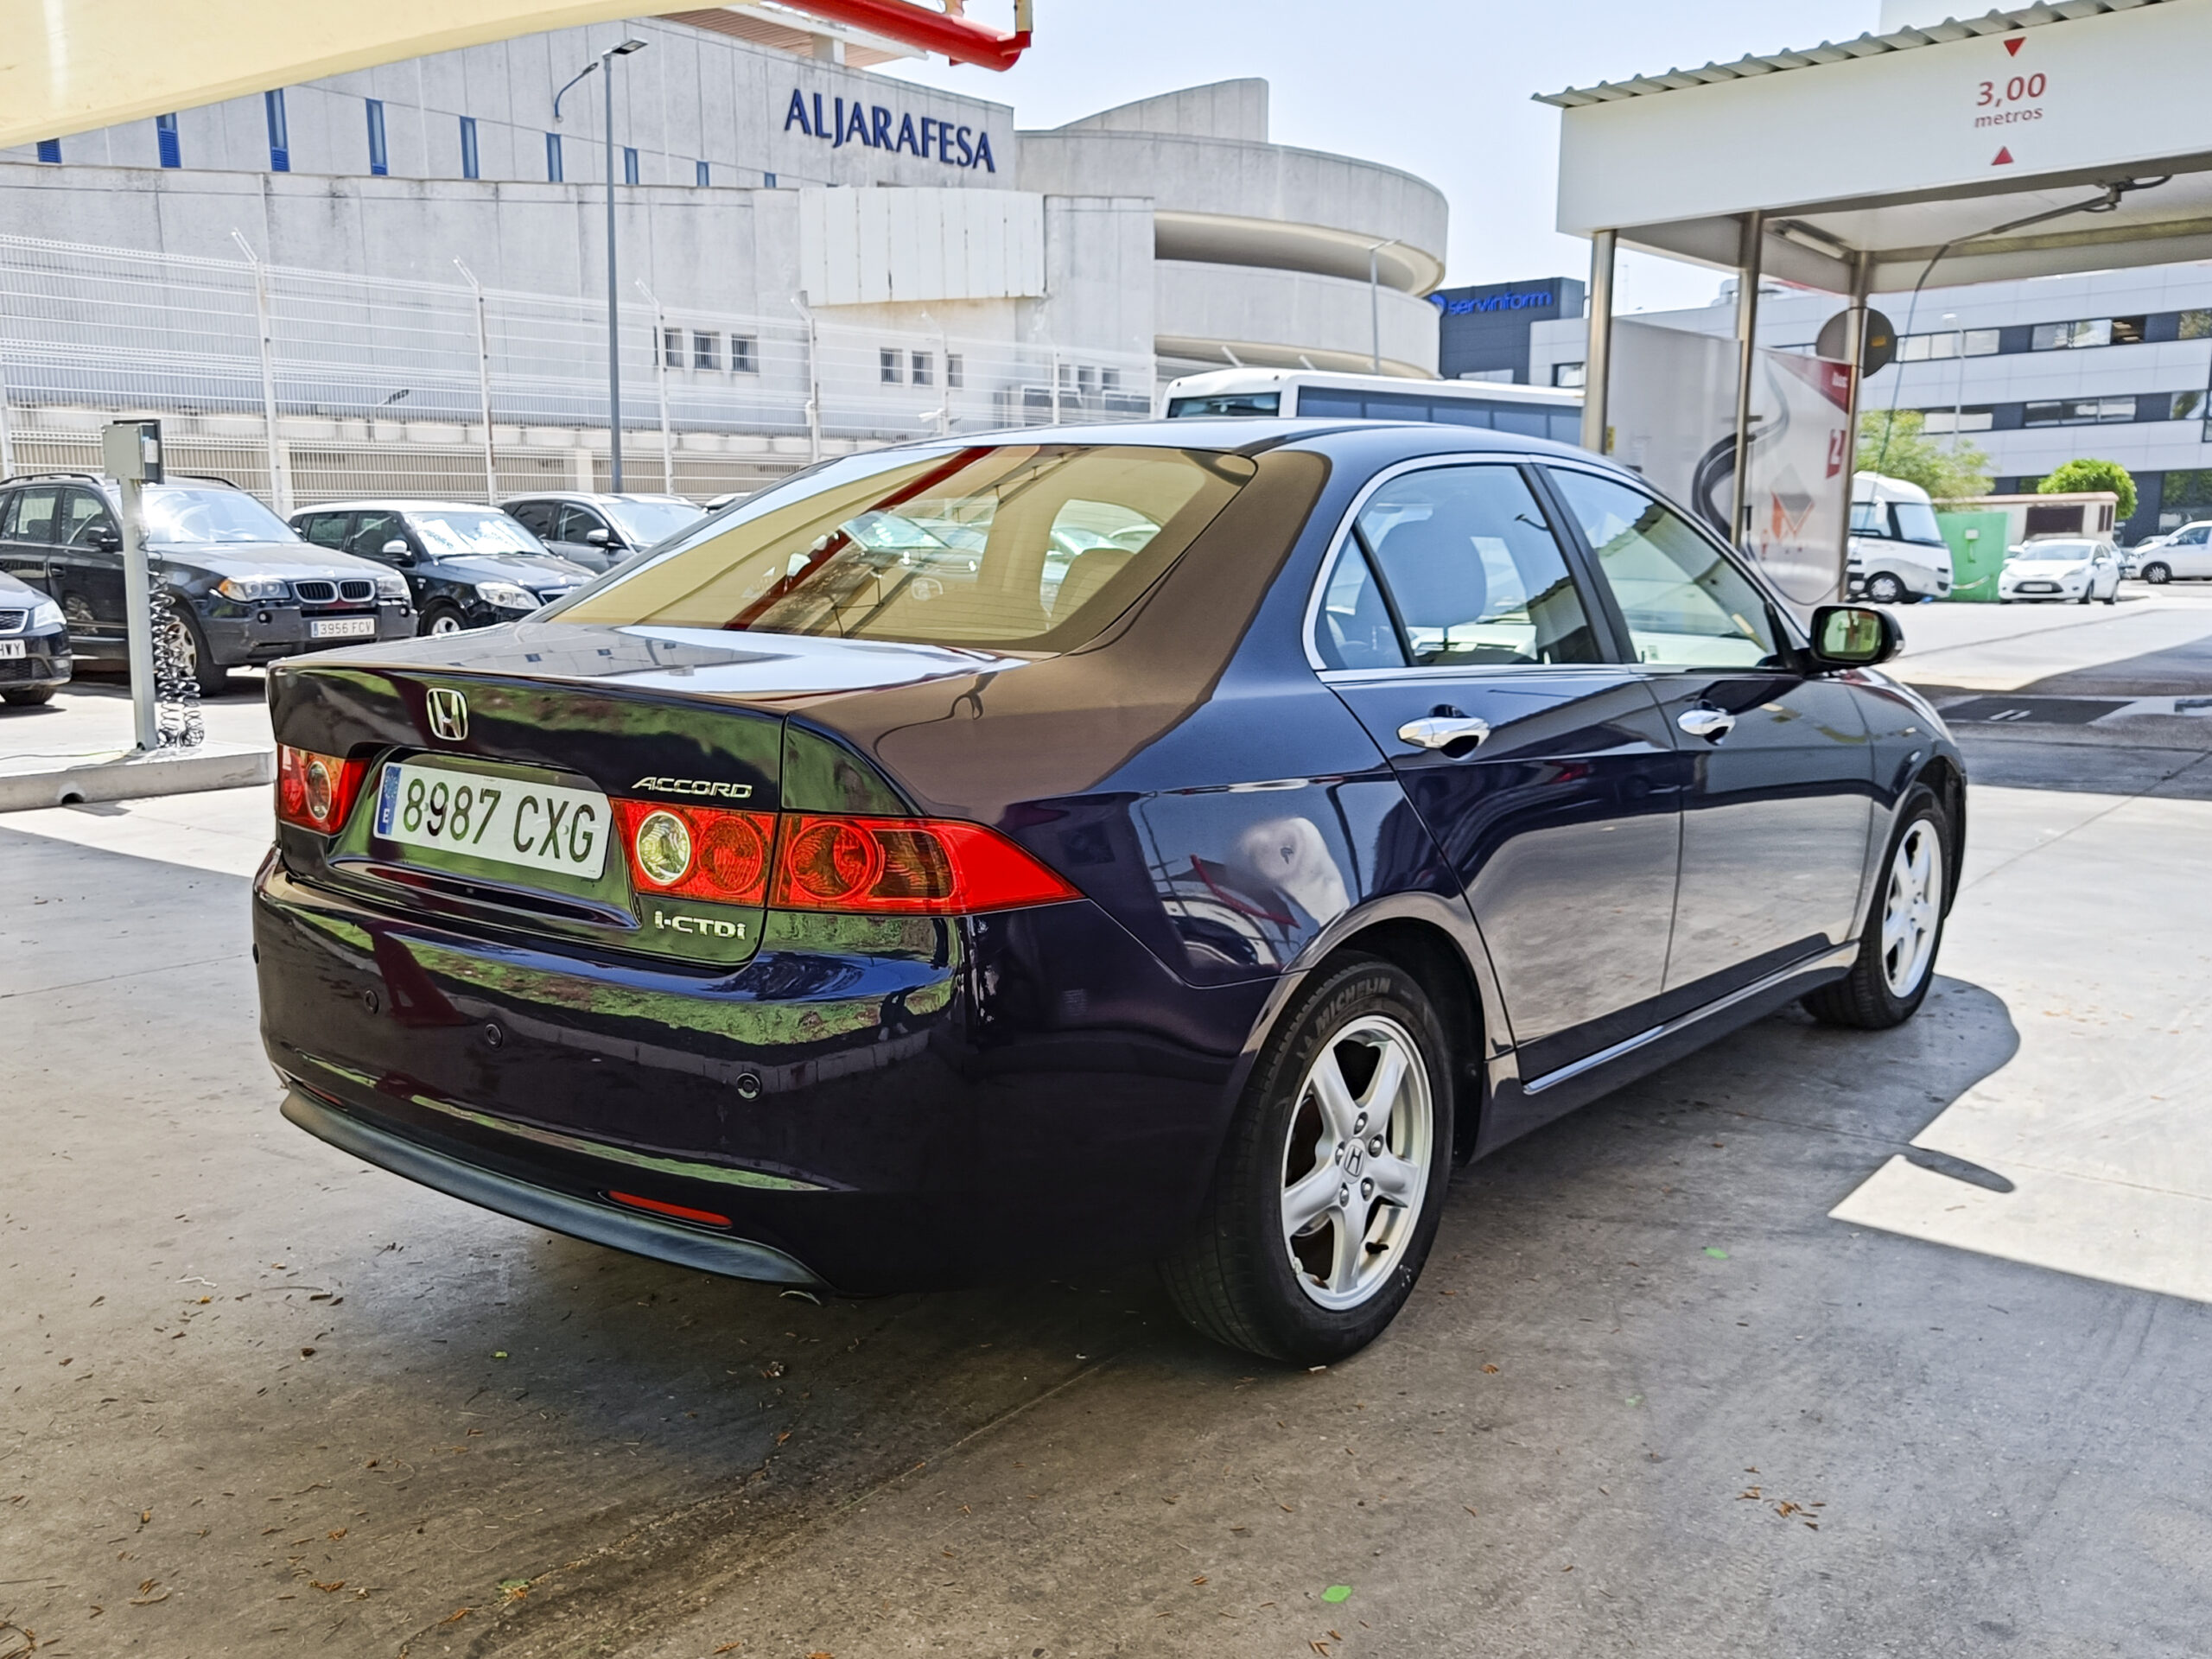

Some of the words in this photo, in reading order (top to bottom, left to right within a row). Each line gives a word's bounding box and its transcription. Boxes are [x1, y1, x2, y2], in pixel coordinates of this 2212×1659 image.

[1976, 72, 2047, 108] 3,00
[784, 88, 995, 174] ALJARAFESA
[1974, 108, 2044, 128] metros
[1448, 290, 1553, 315] servinform
[320, 623, 348, 635] 3956
[352, 621, 372, 633] FCV
[631, 777, 753, 798] ACCORD
[403, 778, 501, 844] 8987
[513, 795, 596, 863] CXG
[1314, 977, 1391, 1036] MICHELIN
